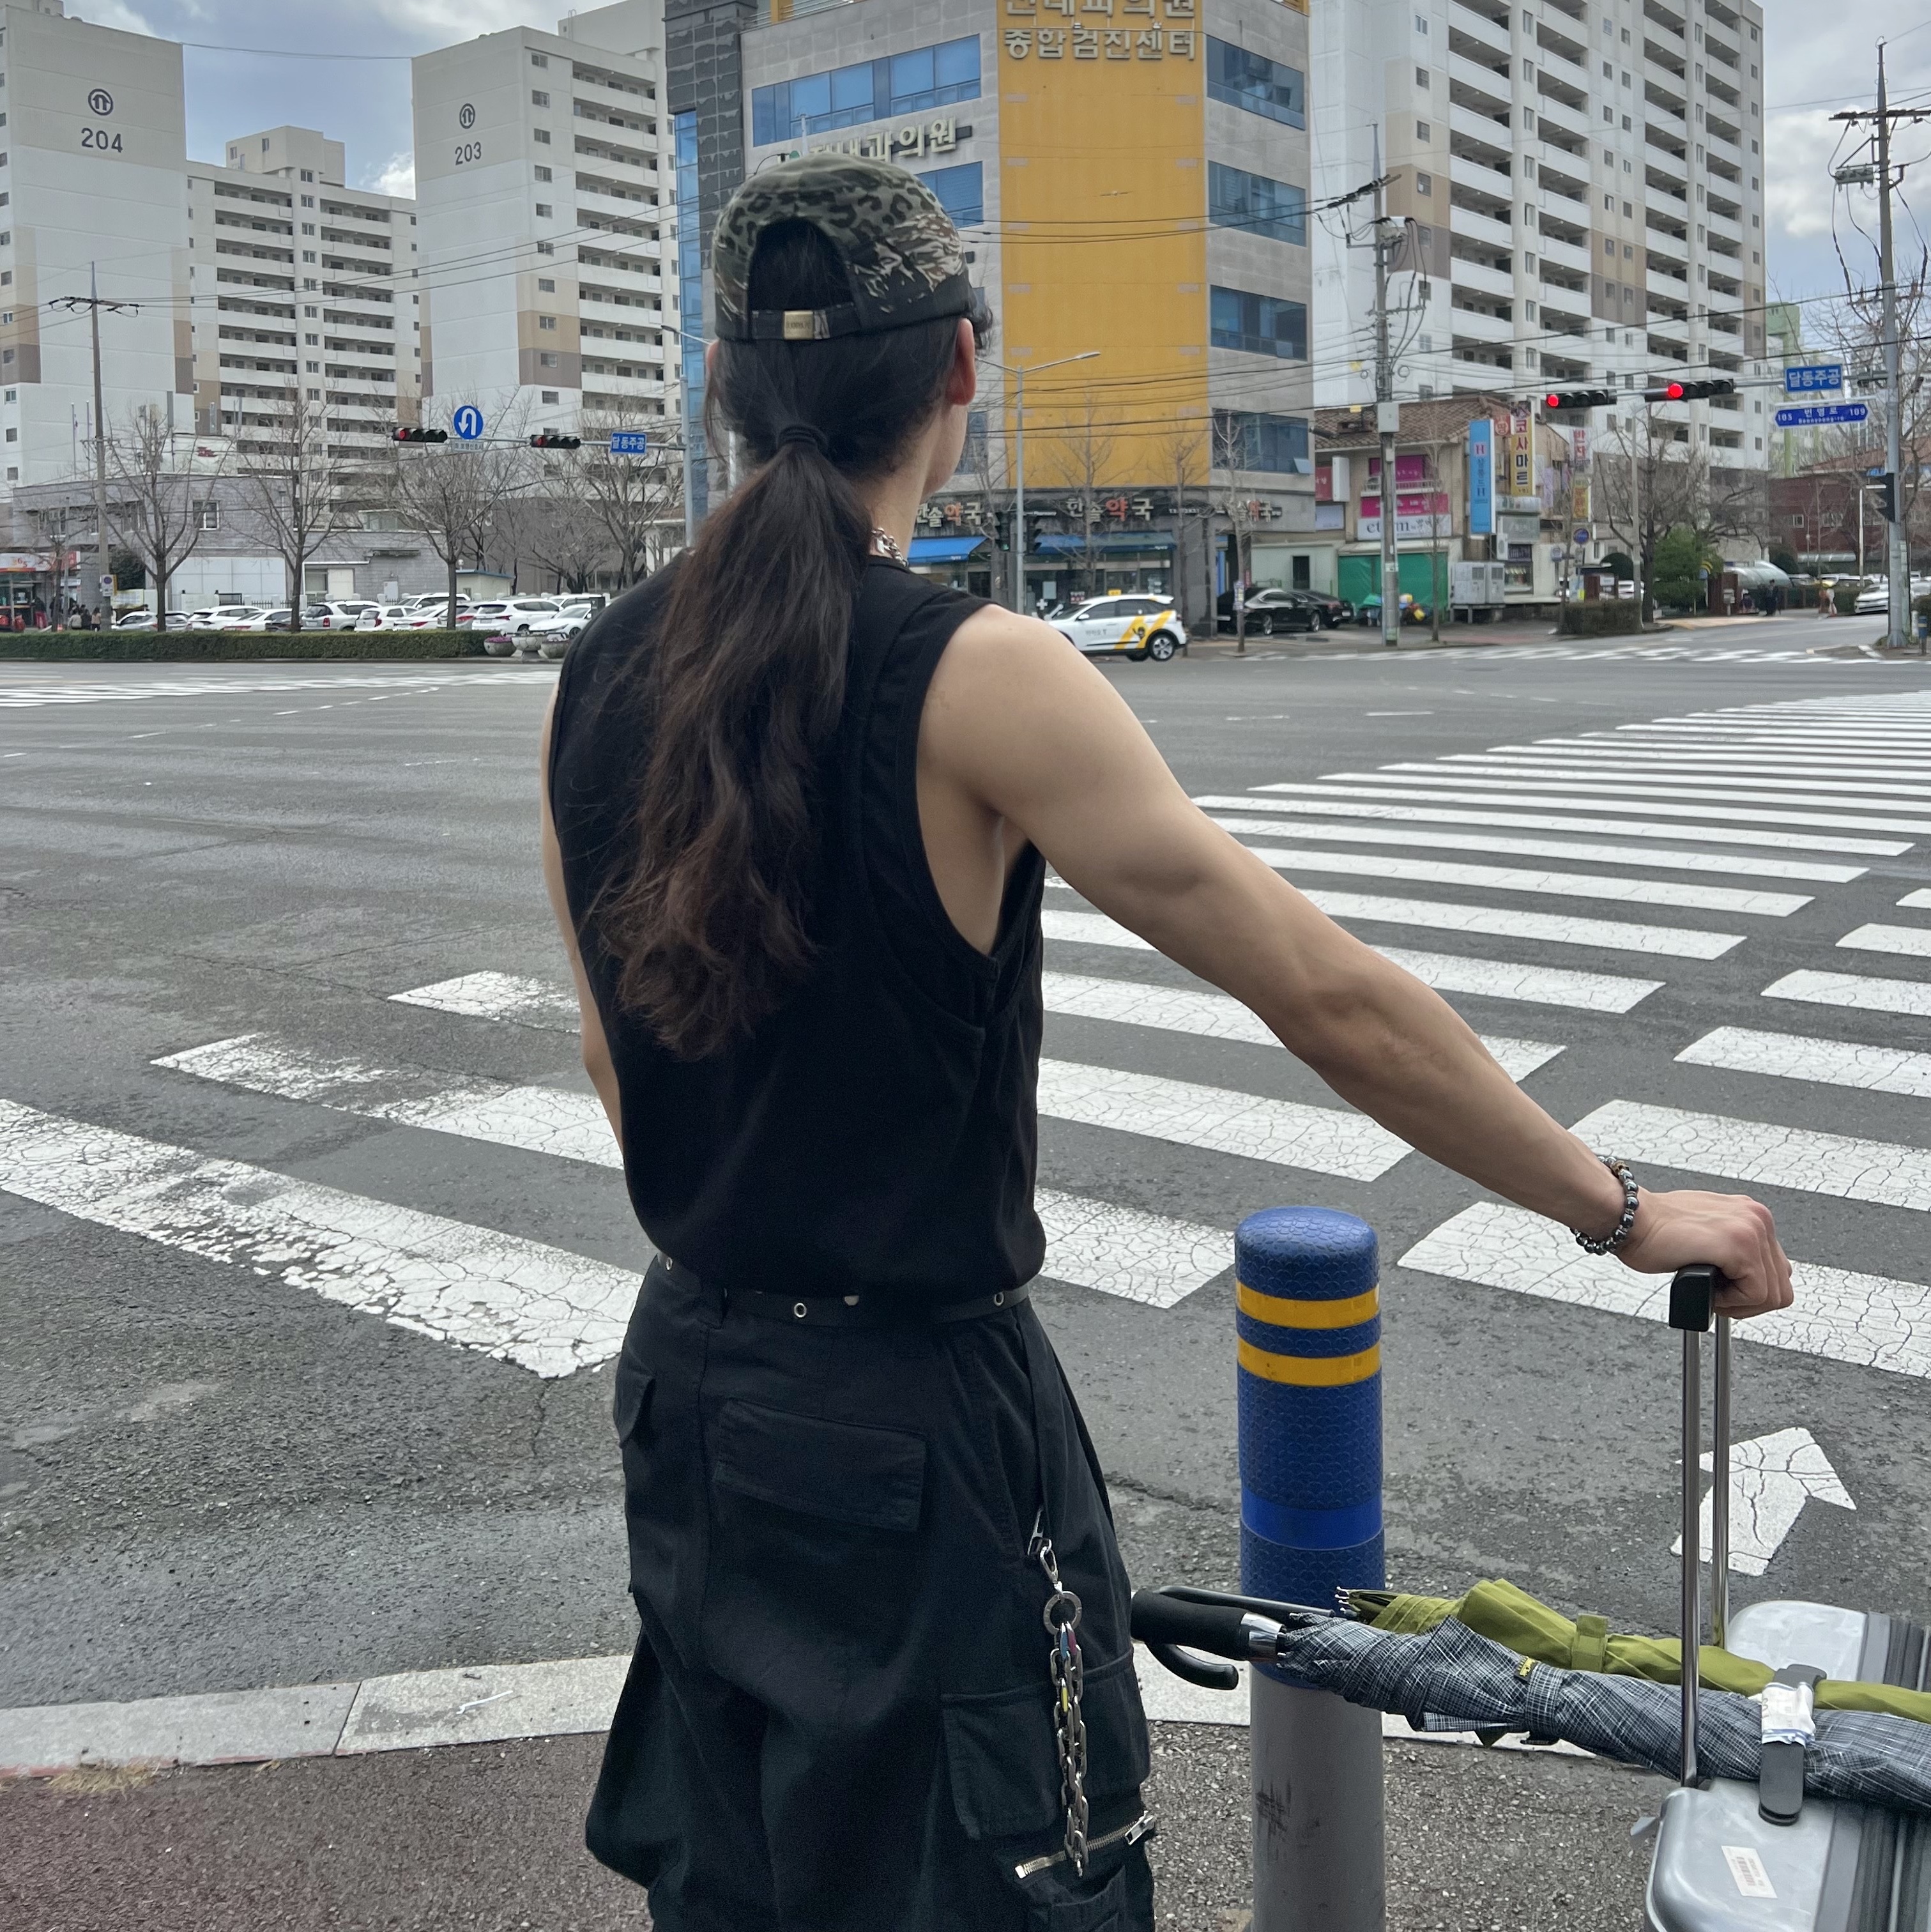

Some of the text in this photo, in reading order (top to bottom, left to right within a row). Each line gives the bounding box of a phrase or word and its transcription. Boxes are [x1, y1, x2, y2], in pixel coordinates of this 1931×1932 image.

[1004, 29, 1194, 61] 종합검진센터
[81, 127, 123, 153] 204
[455, 141, 482, 166] 203
[1789, 369, 1840, 388] 달동주공
[1804, 406, 1838, 418] 번영로
[1850, 407, 1865, 416] 109
[613, 436, 645, 450] 달동주공
[1515, 419, 1529, 486] 코사마트
[916, 501, 984, 528] 한솔약국
[1065, 496, 1154, 522] 한솔약국
